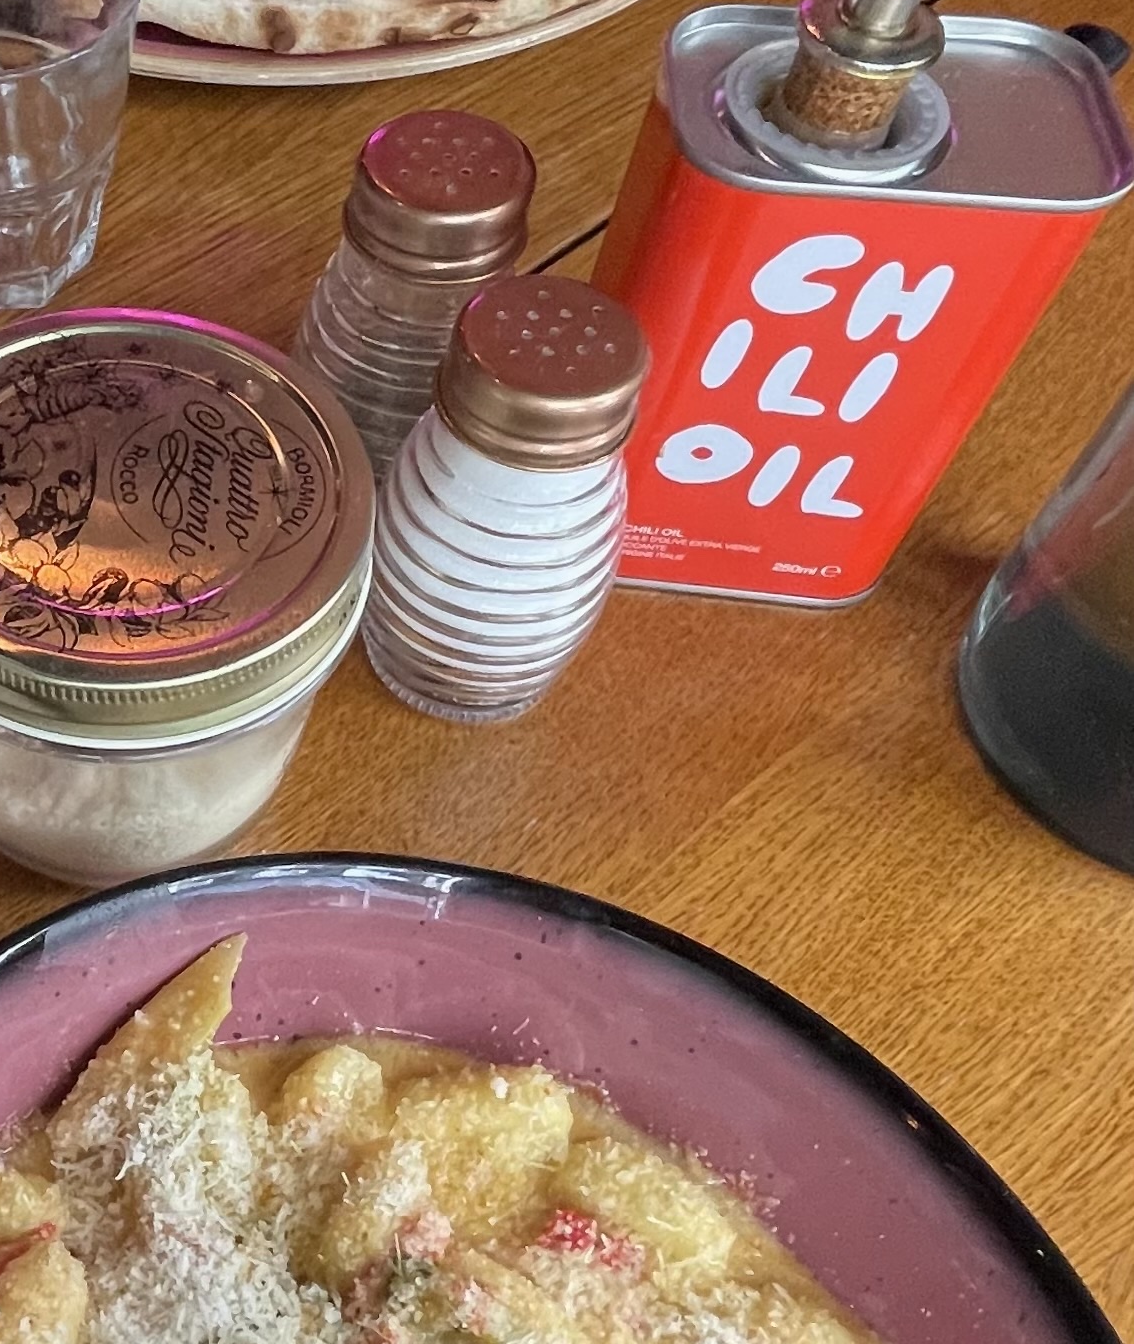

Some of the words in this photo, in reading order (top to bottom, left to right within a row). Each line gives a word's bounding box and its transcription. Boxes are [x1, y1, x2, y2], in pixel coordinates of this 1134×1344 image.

[750, 234, 955, 342] CH
[700, 318, 899, 423] ILI
[119, 443, 151, 505] ROCCO
[169, 400, 231, 565] Stagioni
[224, 426, 274, 553] Quattro
[278, 447, 315, 536] BORMIOLI
[654, 423, 864, 519] OIL
[661, 528, 684, 538] OIL
